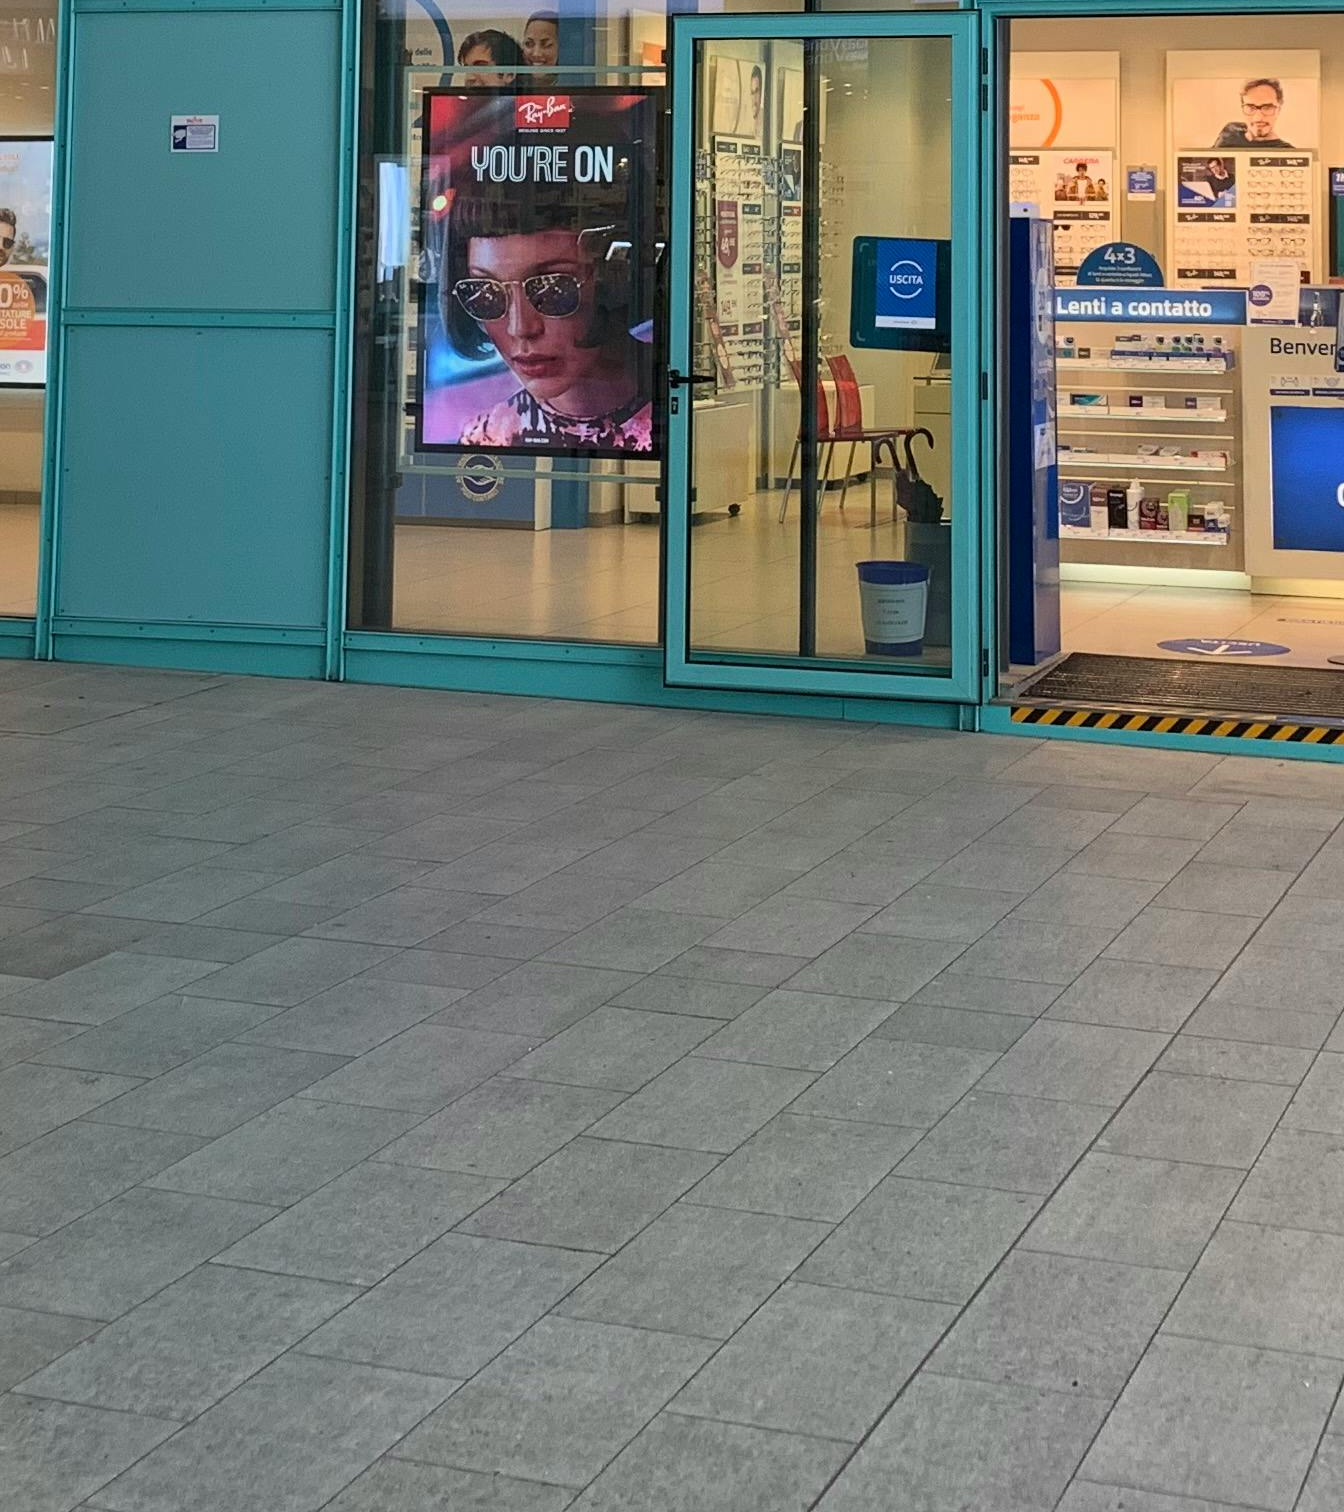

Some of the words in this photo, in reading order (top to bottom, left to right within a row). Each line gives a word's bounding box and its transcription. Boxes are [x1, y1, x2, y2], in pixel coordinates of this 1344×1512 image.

[518, 96, 567, 124] Ray-Ban
[471, 145, 569, 183] YOU'RE
[574, 145, 614, 183] ON
[1103, 247, 1136, 264] 4x3
[889, 274, 924, 285] USCITA
[1056, 296, 1106, 316] Lenti
[1111, 302, 1123, 316] a
[1127, 299, 1213, 318] contatto
[0, 319, 27, 329] SOLE
